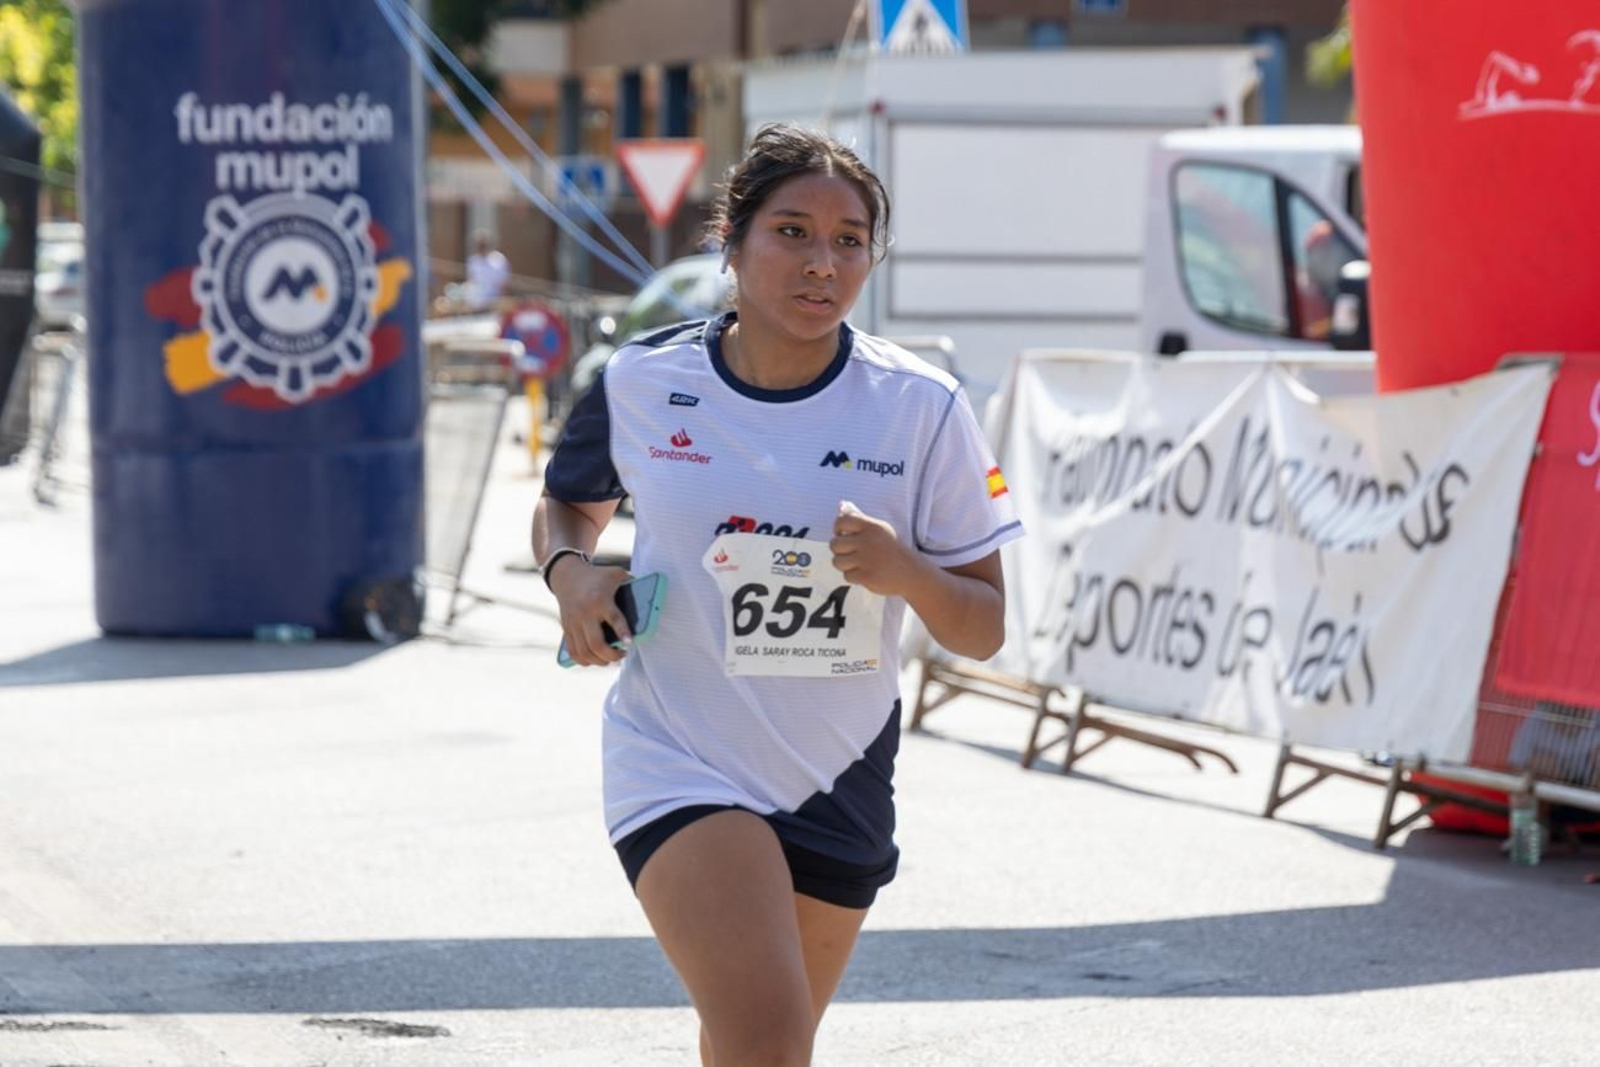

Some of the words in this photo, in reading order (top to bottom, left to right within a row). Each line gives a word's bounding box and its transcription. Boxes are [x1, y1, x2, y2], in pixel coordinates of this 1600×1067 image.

[175, 91, 393, 143] fundación
[215, 144, 360, 198] mupol
[649, 446, 712, 464] Santander
[857, 459, 904, 477] mupol
[731, 583, 851, 638] 654
[762, 646, 790, 657] SARAY
[791, 647, 815, 657] ROCA
[817, 647, 847, 657] TICONA
